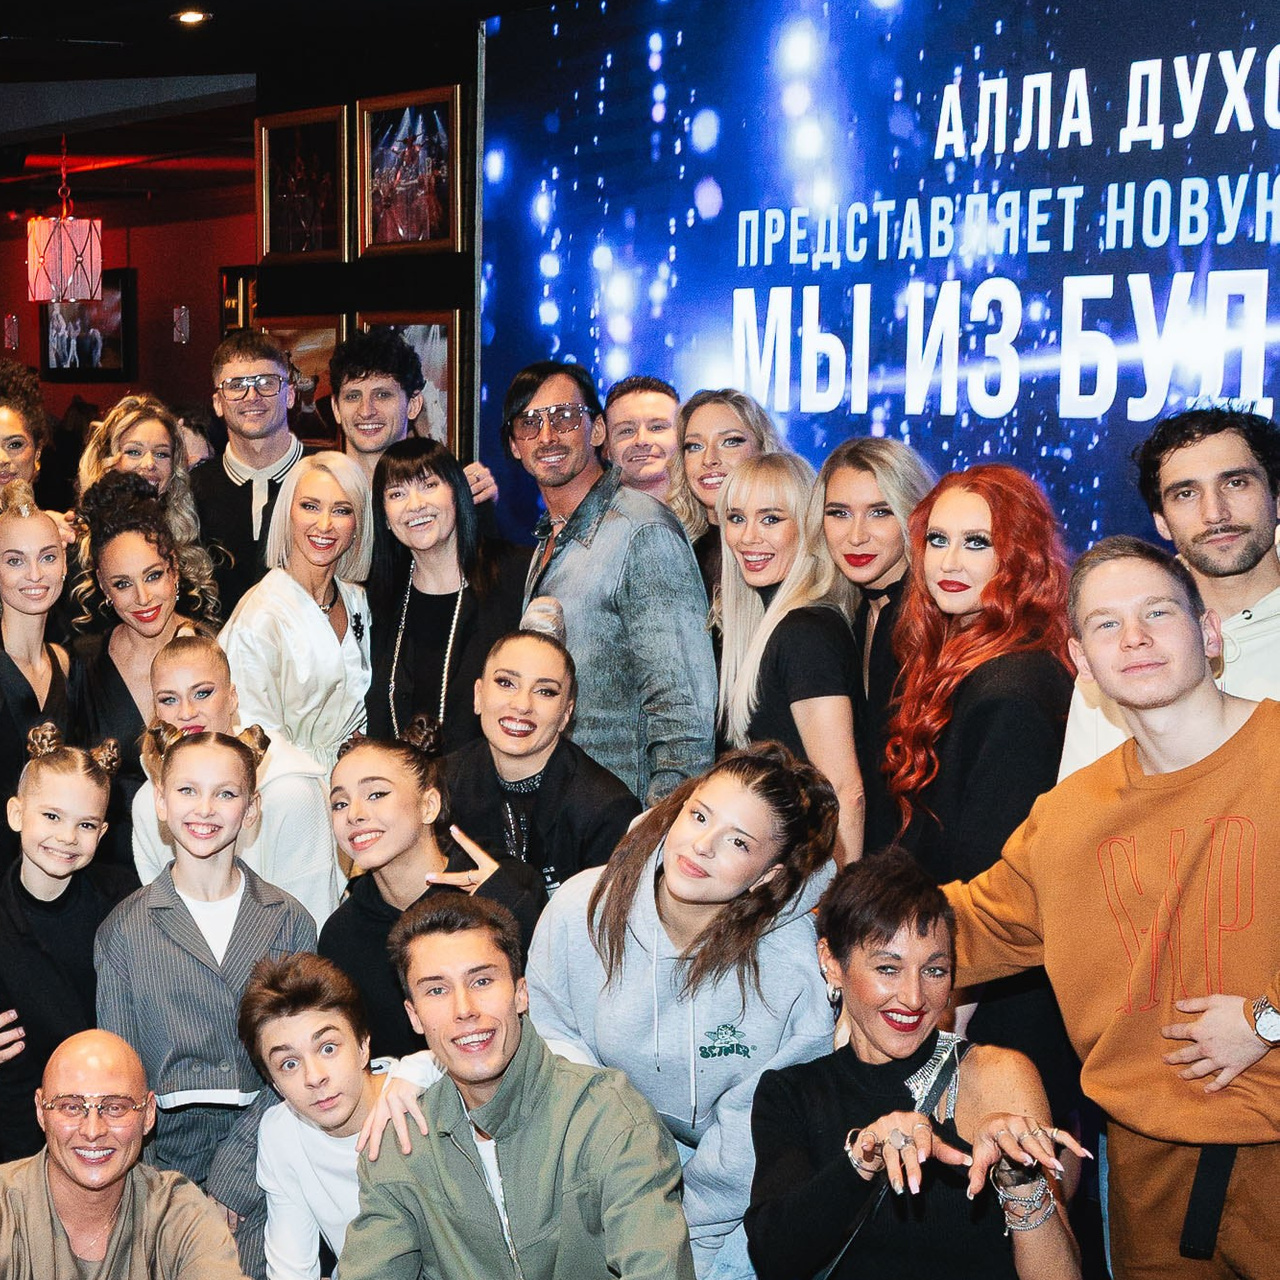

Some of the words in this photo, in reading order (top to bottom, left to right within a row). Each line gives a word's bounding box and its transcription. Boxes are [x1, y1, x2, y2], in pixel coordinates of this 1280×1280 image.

[933, 68, 1093, 160] АЛЛА
[736, 185, 1084, 270] ПРЕДСТАВЛЯЕТ
[732, 283, 872, 414] МЫ
[904, 276, 1022, 419] ИЗ
[1058, 268, 1274, 422] БУД
